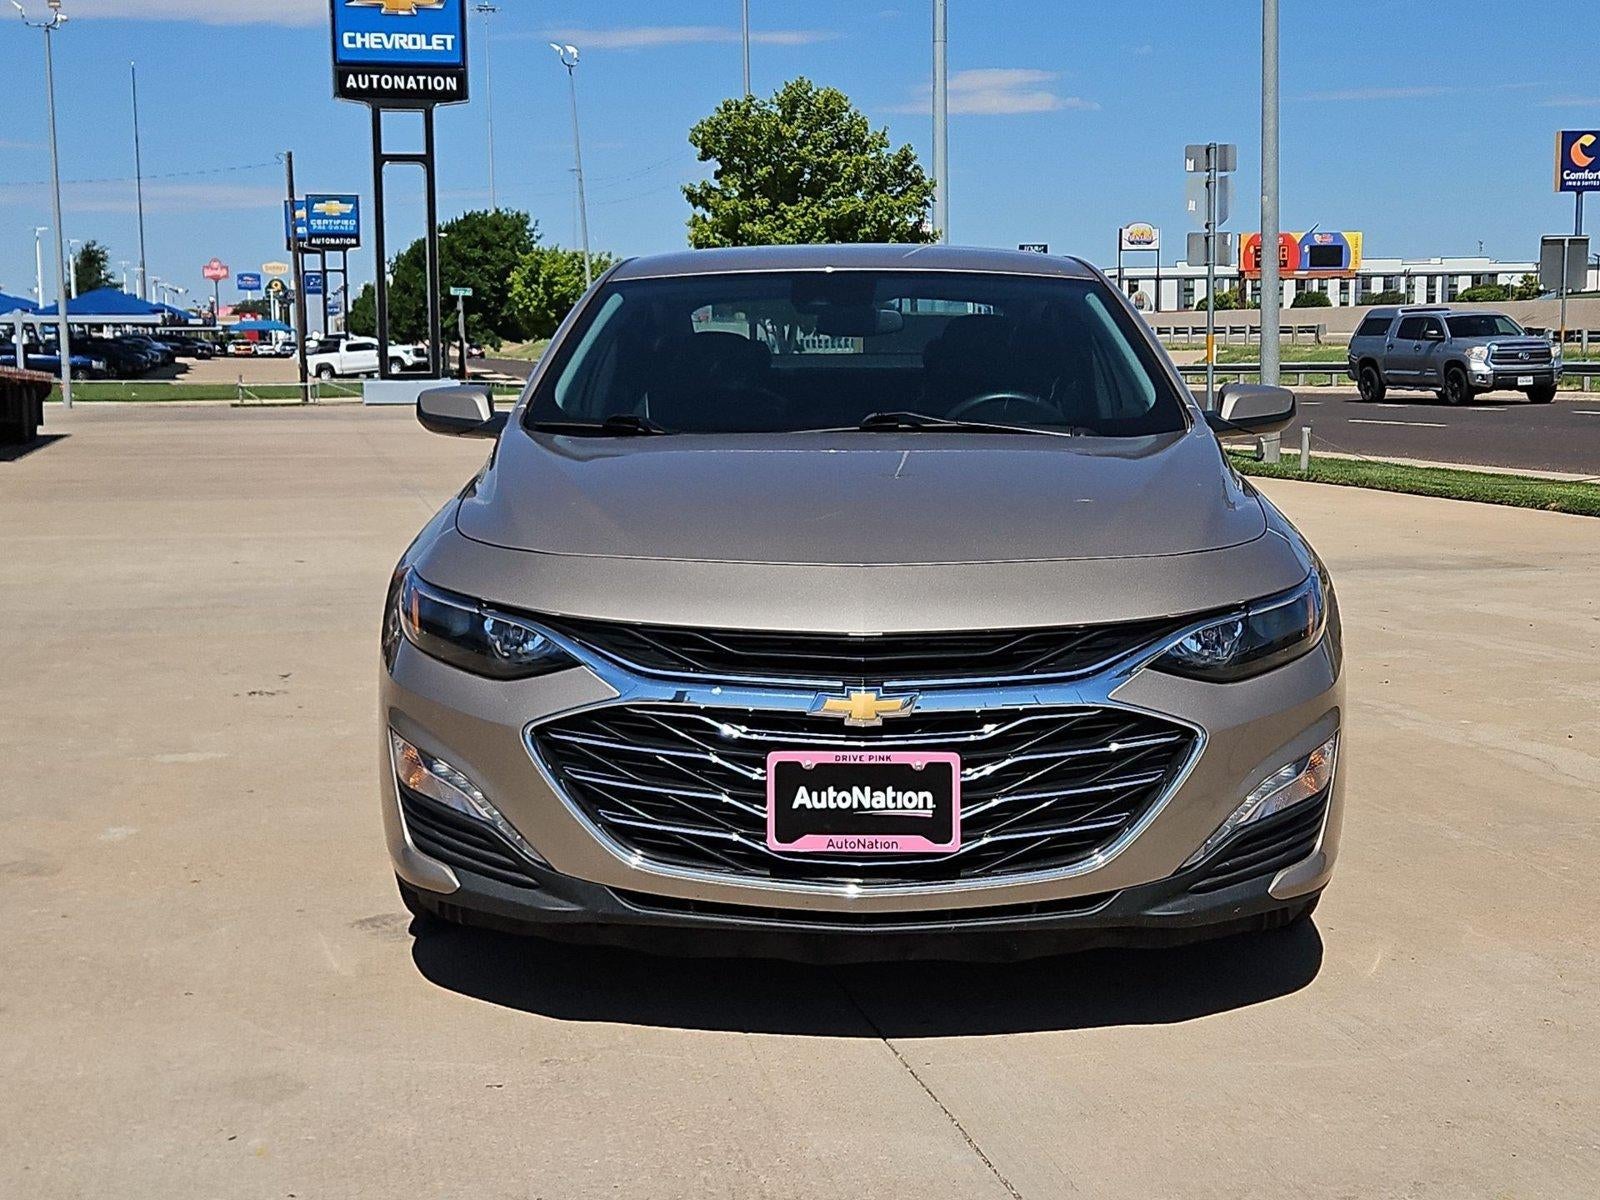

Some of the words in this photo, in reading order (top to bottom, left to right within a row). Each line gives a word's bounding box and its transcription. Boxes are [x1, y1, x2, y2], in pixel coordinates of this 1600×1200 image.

[342, 32, 455, 50] CHEVROLET
[346, 74, 457, 91] AUTONATION
[311, 237, 357, 245] AUTONATION
[834, 754, 865, 762] DRIVE
[791, 785, 936, 810] AutoNation
[826, 837, 899, 850] AutoNation
